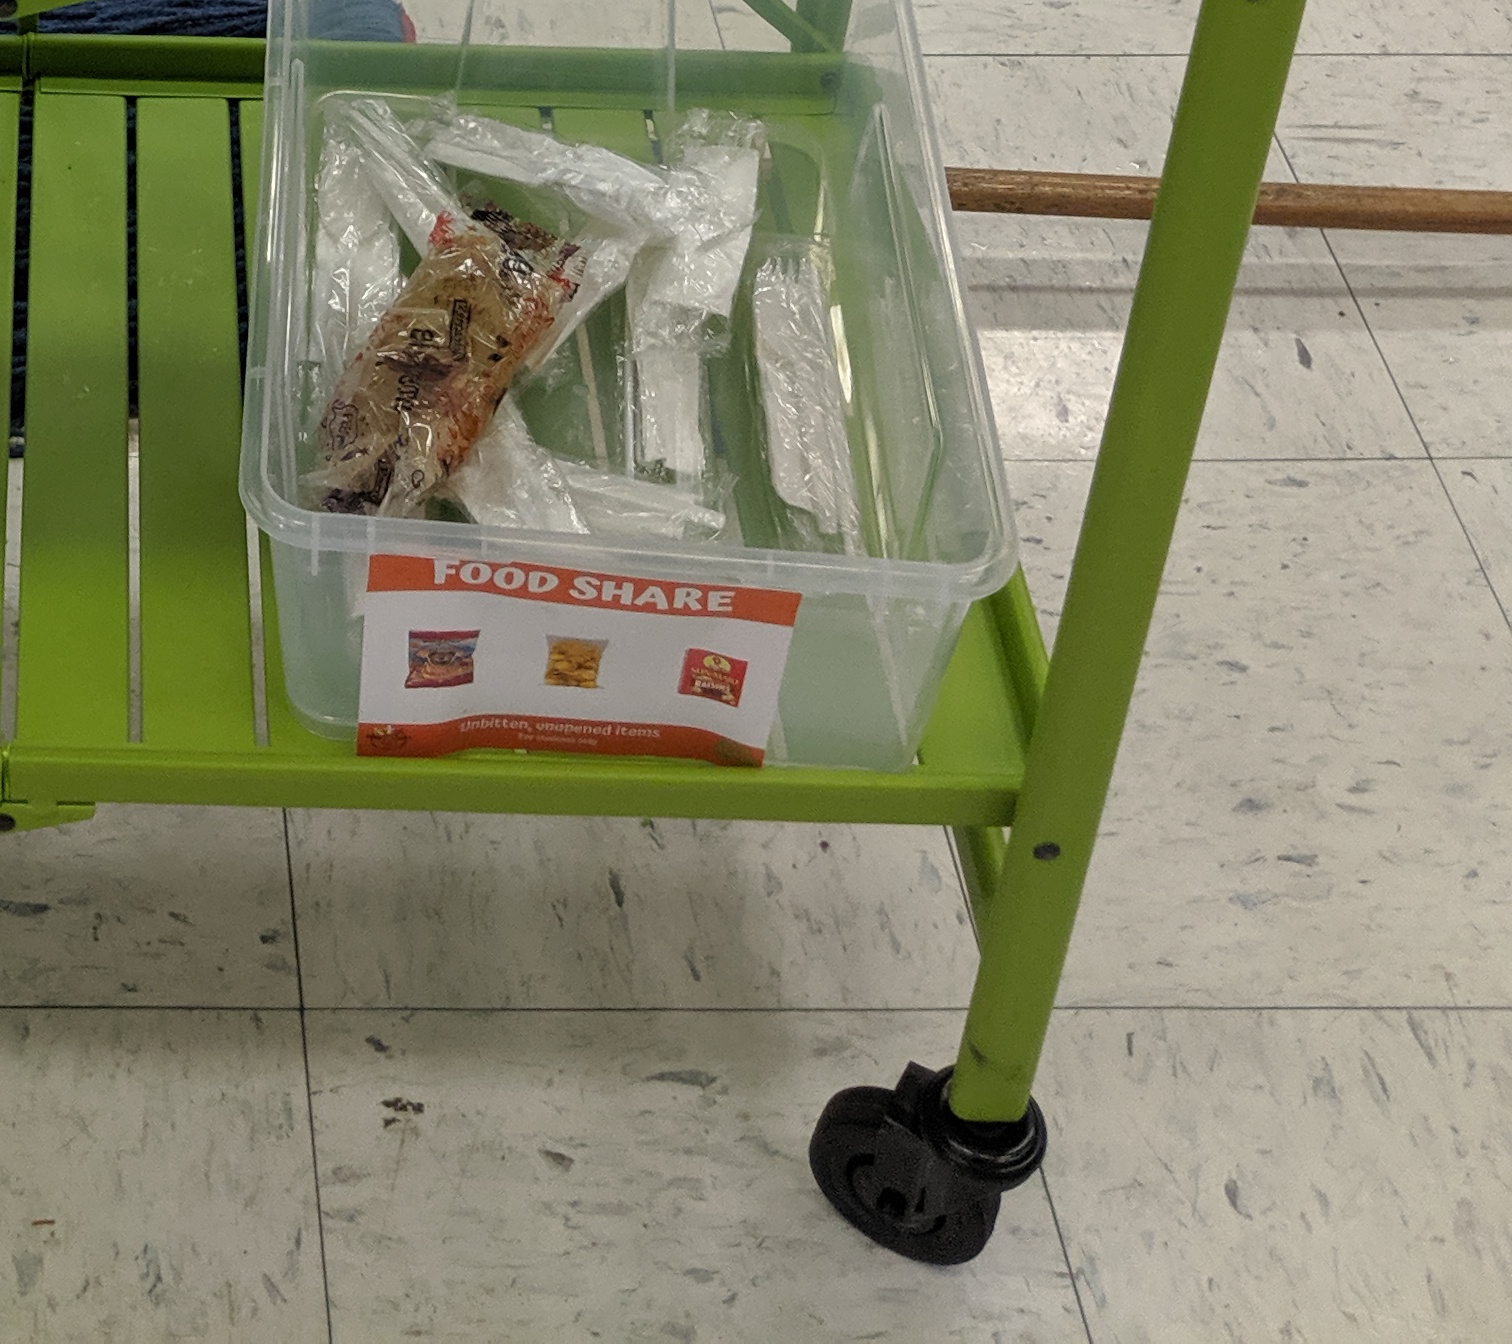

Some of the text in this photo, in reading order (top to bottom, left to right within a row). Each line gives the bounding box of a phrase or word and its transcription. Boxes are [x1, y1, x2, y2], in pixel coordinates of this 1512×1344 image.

[433, 557, 737, 613] FOOD SHARE
[459, 717, 662, 739] Unbitten, unopened items
